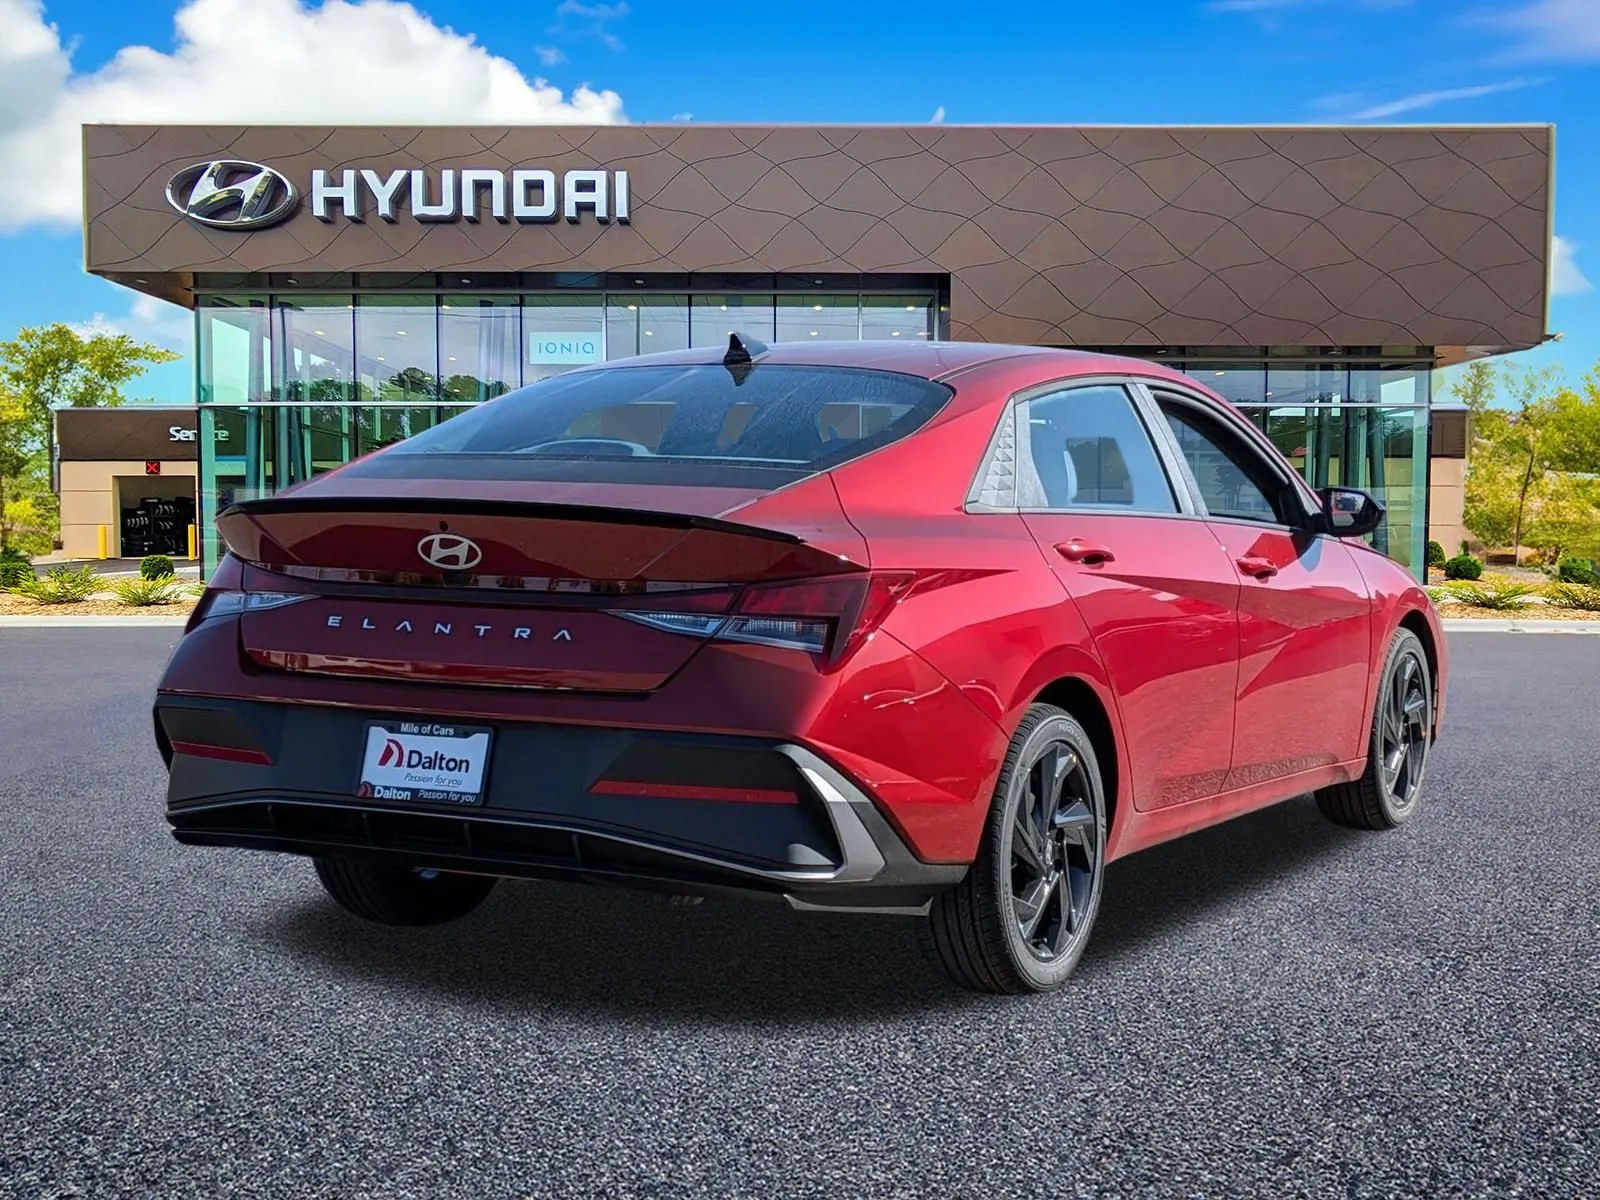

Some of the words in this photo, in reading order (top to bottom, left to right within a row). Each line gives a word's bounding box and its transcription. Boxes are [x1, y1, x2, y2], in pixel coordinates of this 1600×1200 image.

[311, 168, 631, 224] HYUNDAI
[538, 341, 595, 354] IONIQ
[169, 426, 229, 441] Sere
[327, 615, 573, 641] ELANTRA
[400, 722, 419, 733] Mile
[421, 724, 432, 735] of
[432, 725, 455, 736] Cars
[406, 749, 470, 773] Dalton
[403, 772, 434, 784] Passion
[434, 775, 448, 786] for
[448, 779, 463, 787] you
[374, 786, 411, 801] Dalton
[418, 789, 448, 800] Passion
[448, 790, 461, 801] for
[460, 794, 477, 803] you
